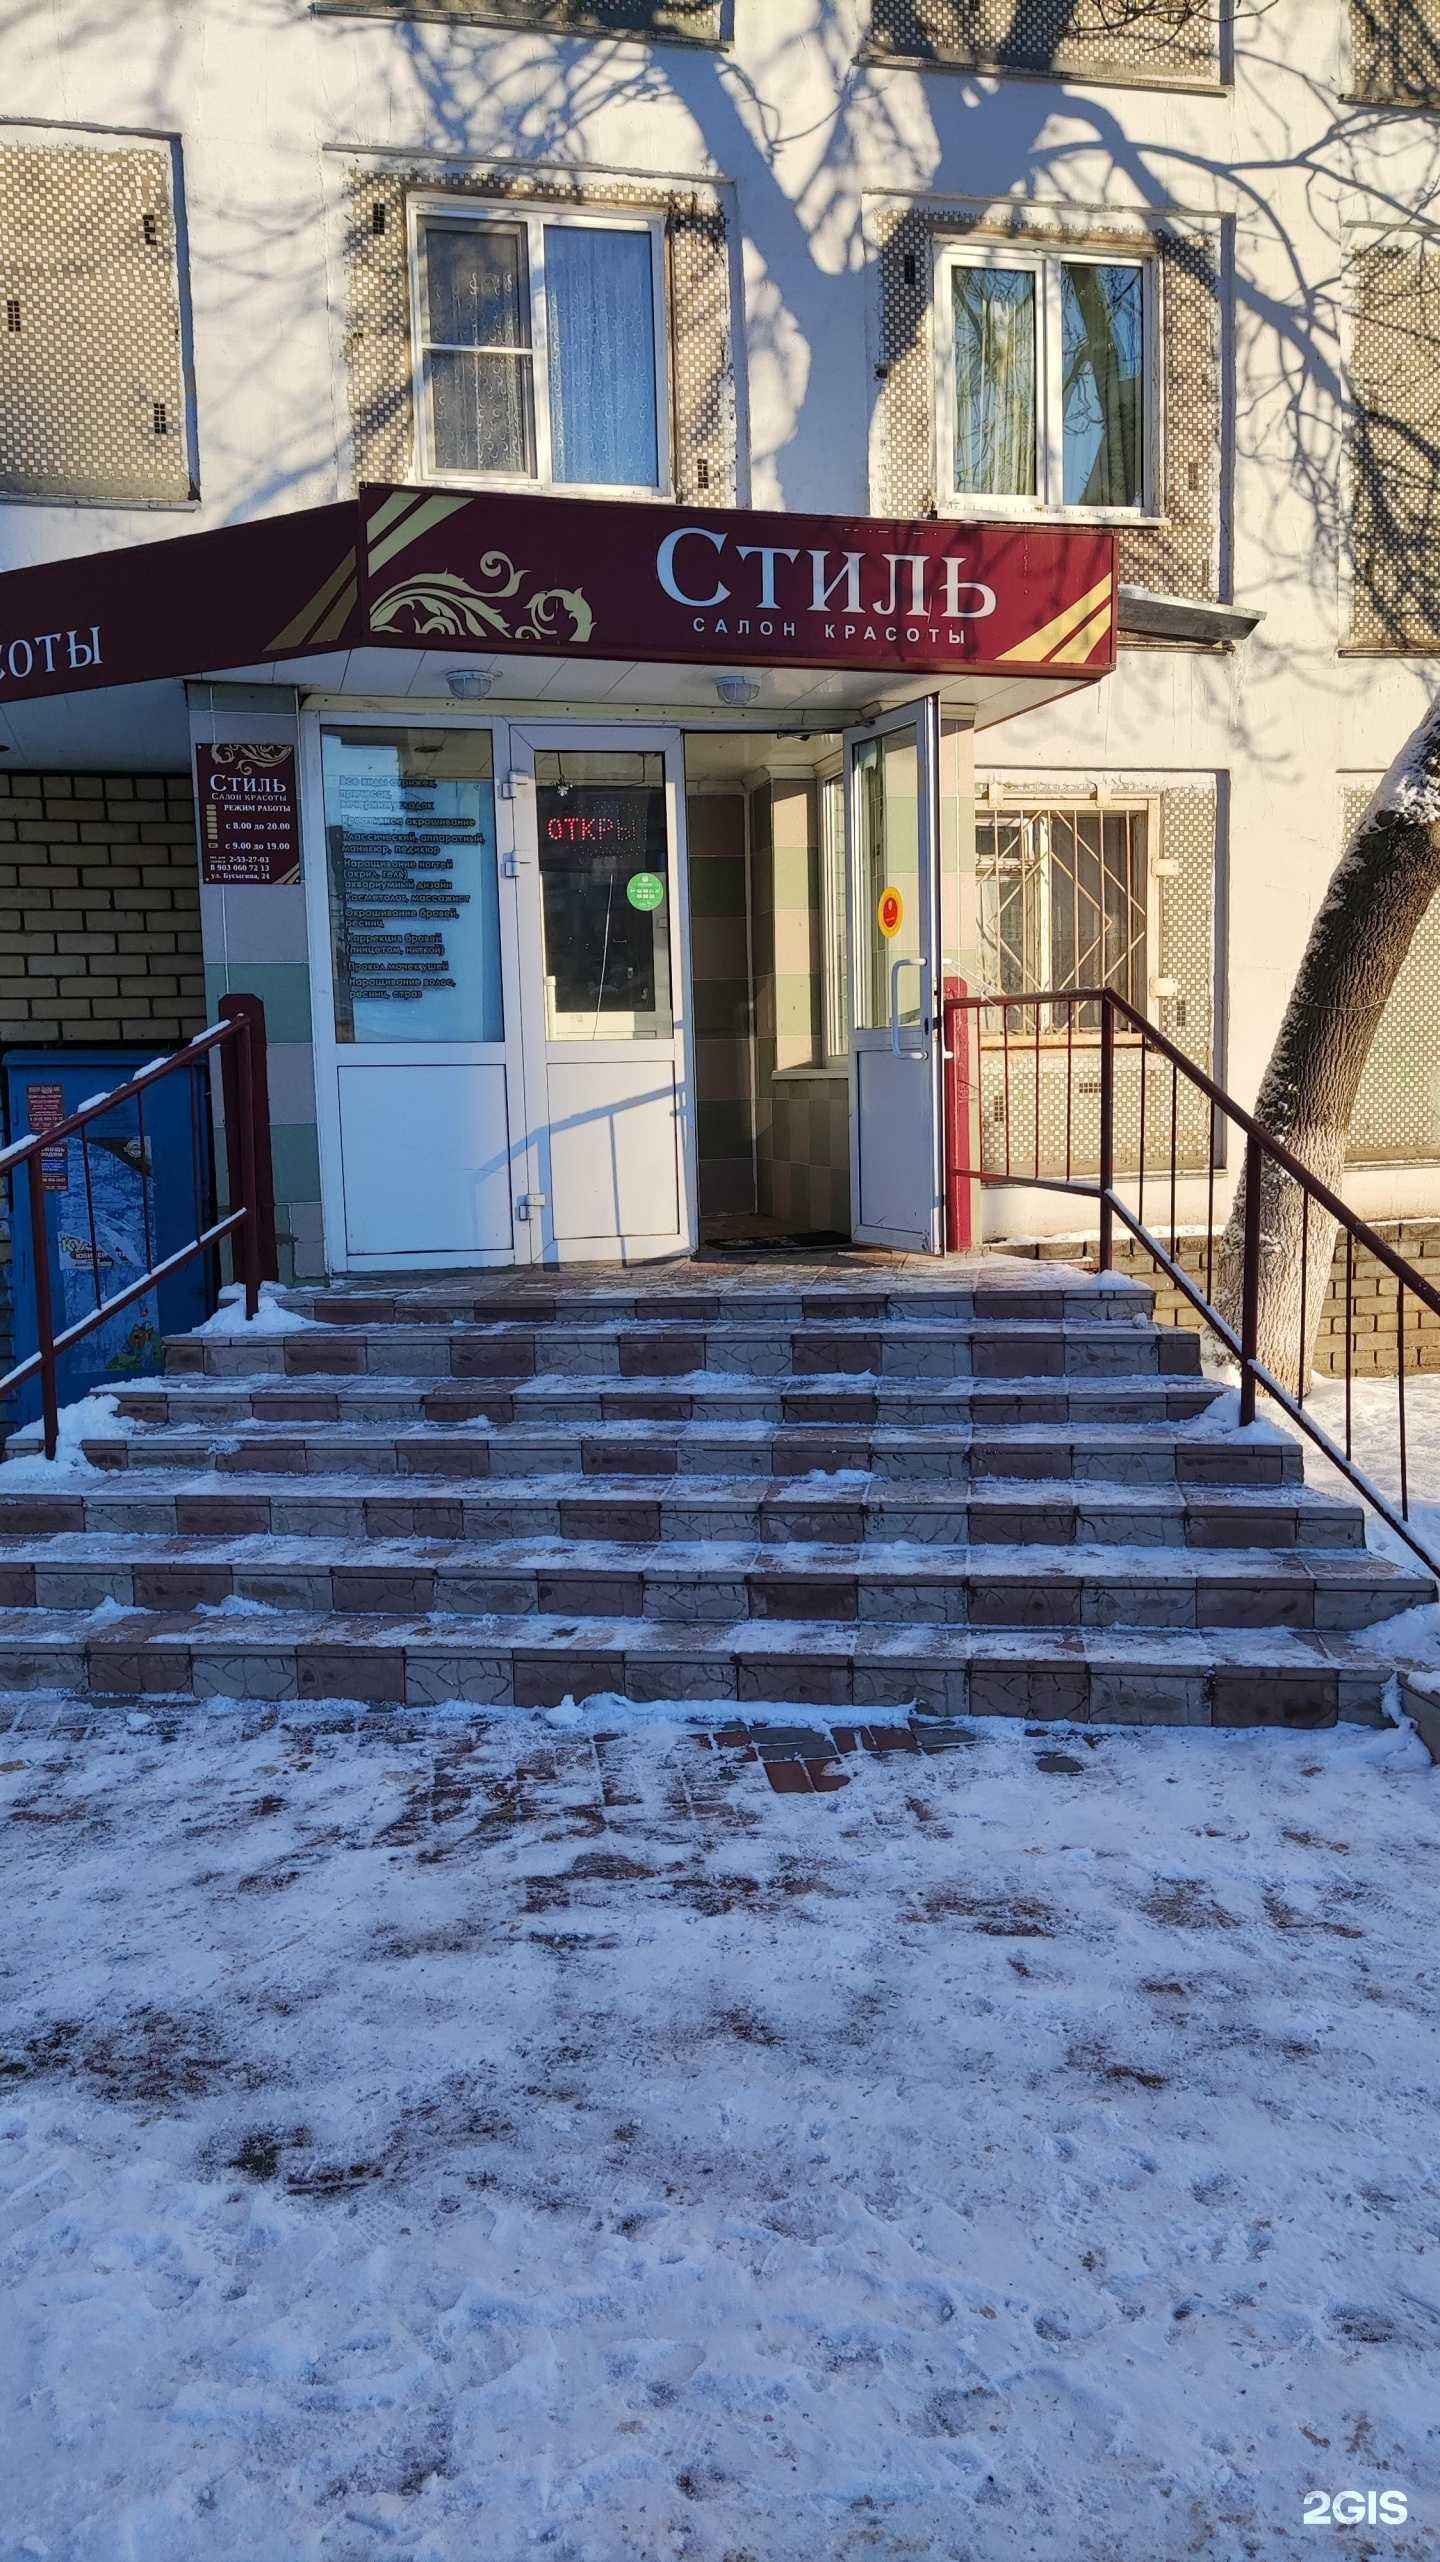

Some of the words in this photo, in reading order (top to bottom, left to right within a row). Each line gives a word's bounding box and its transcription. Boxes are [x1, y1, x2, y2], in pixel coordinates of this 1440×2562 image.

[692, 617, 797, 638] САЛОН
[824, 624, 966, 645] КРАСОТЫ
[224, 804, 256, 812] РЕЖИМ
[257, 804, 292, 813] РАБОТЫ
[233, 822, 252, 830] 8.00
[266, 822, 290, 831] 20.00
[232, 842, 251, 850] 9.00
[267, 842, 290, 850] 19.00
[249, 864, 258, 872] 72
[261, 864, 270, 872] 13
